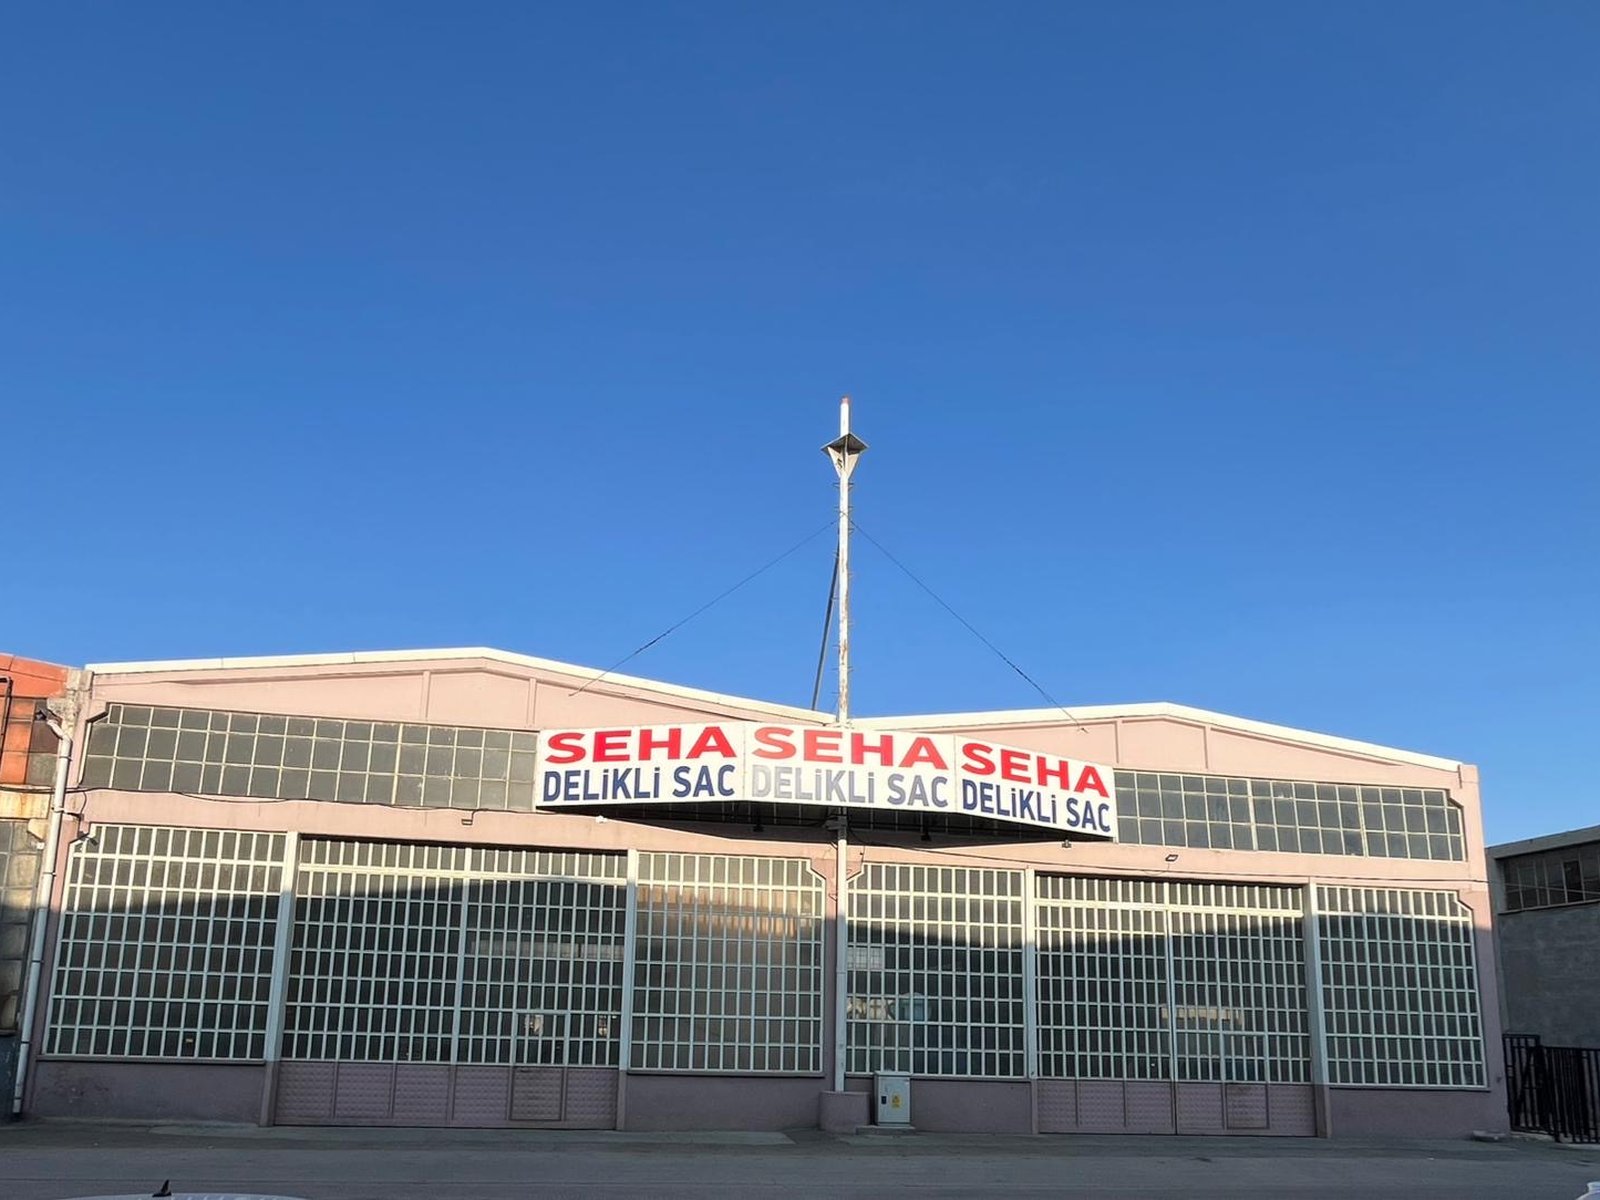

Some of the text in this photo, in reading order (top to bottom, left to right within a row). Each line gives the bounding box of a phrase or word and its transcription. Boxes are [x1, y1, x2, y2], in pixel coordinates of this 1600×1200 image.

[546, 727, 736, 764] SEHA
[752, 727, 948, 769] SEHA
[672, 764, 735, 797] SAC
[962, 742, 1110, 797] SEHA
[887, 773, 949, 808] SAC
[1066, 796, 1111, 832] SAC
